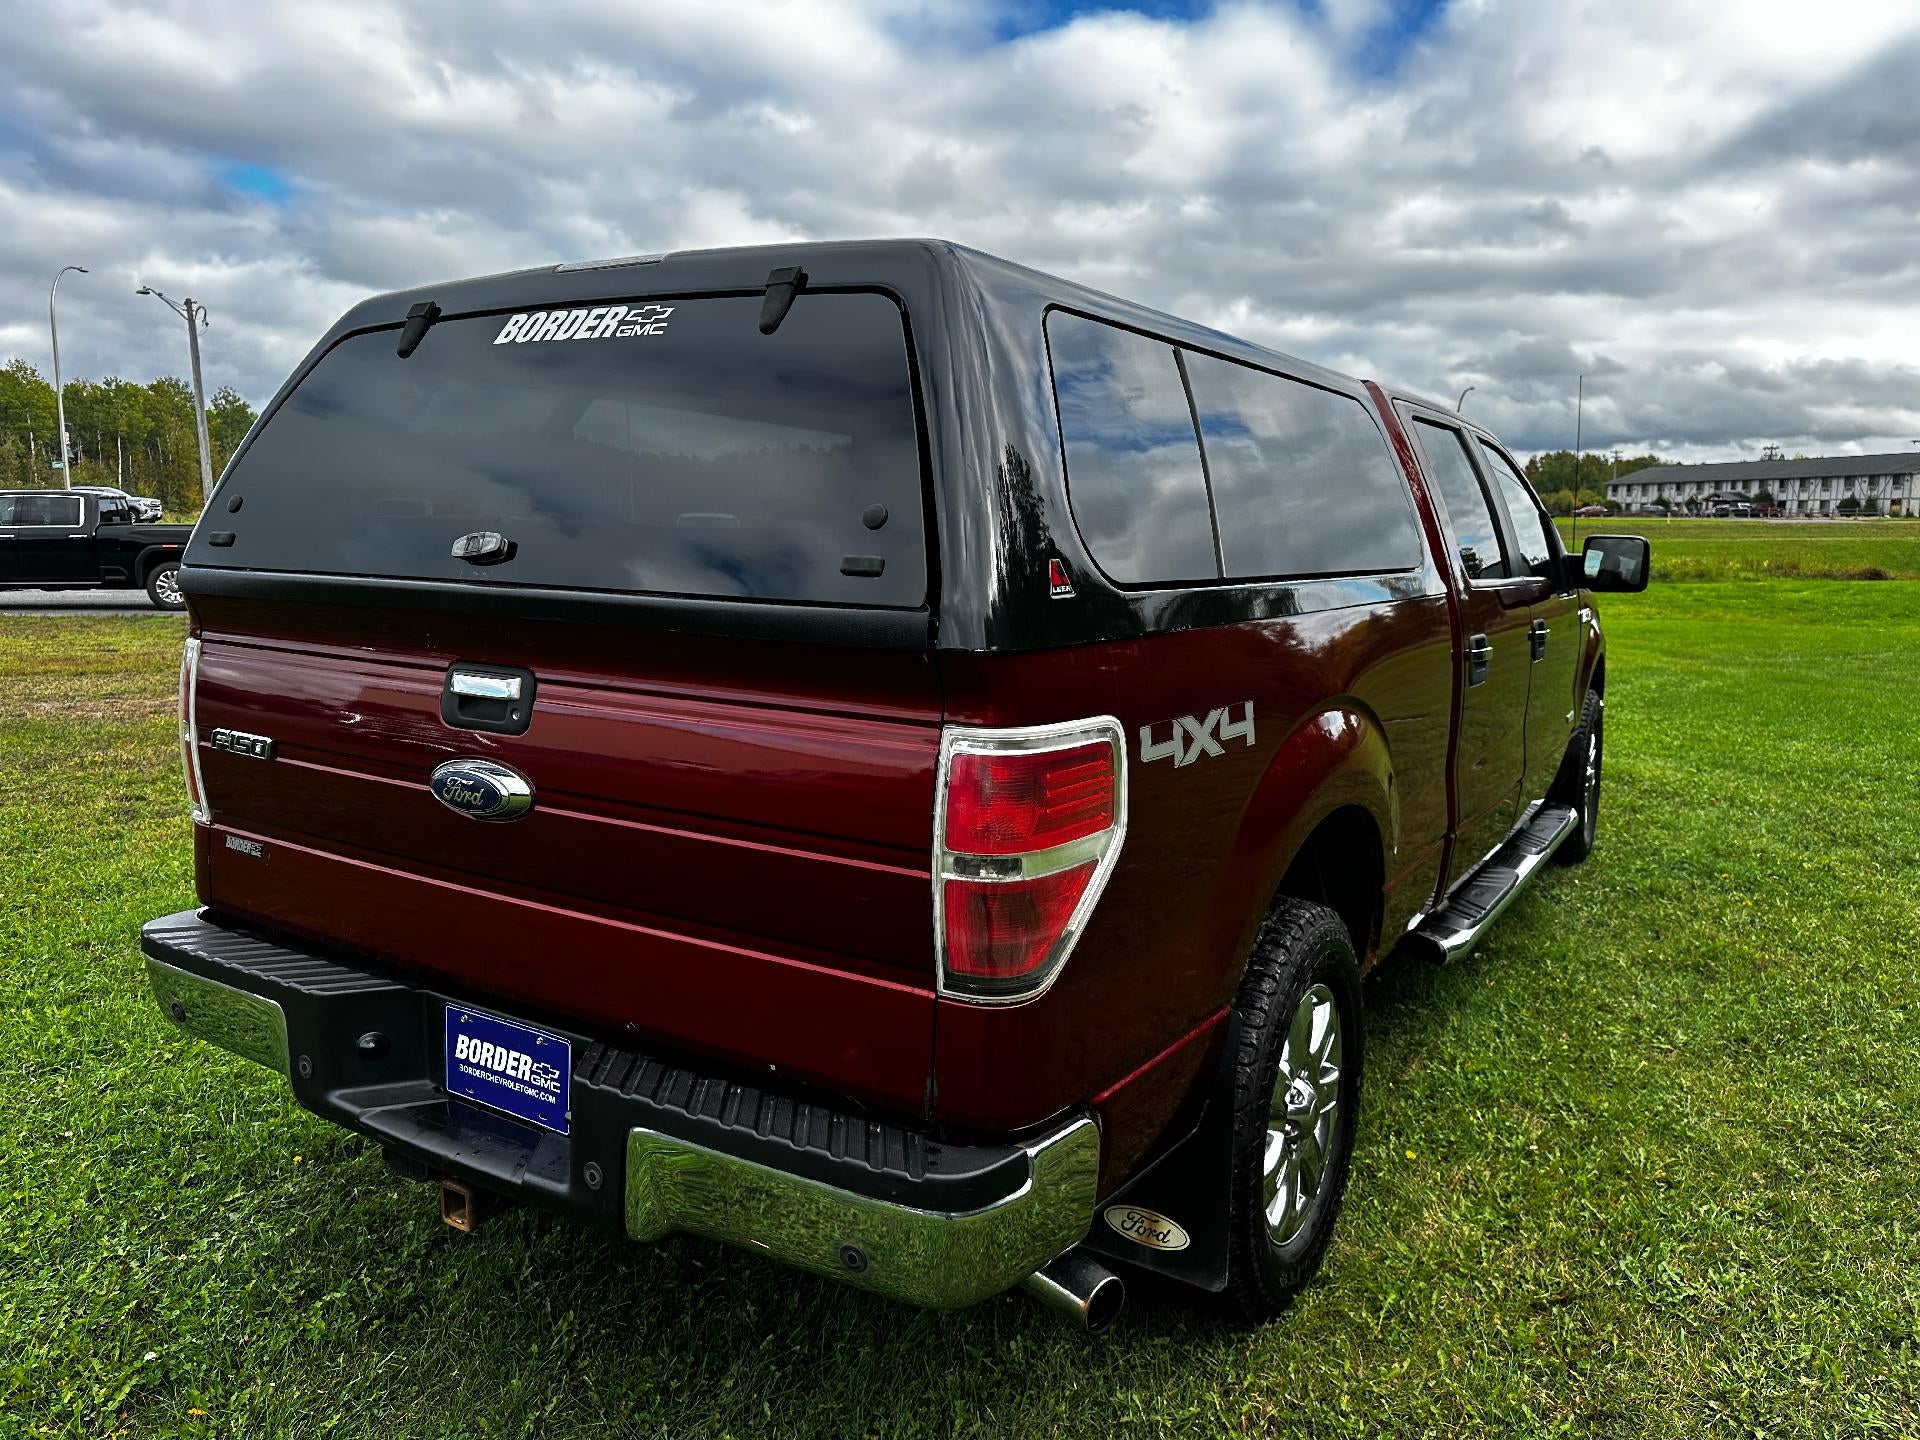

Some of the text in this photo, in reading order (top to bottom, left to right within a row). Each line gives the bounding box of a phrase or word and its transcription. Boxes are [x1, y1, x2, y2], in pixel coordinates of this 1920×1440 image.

[493, 306, 668, 345] BORDER GMC
[442, 776, 485, 806] Ford
[225, 835, 251, 854] BORDER
[455, 1033, 561, 1094] BORDER GMC
[459, 1063, 556, 1105] BORDERCHEVROLETGMC.COM
[1120, 1211, 1172, 1244] Ford
